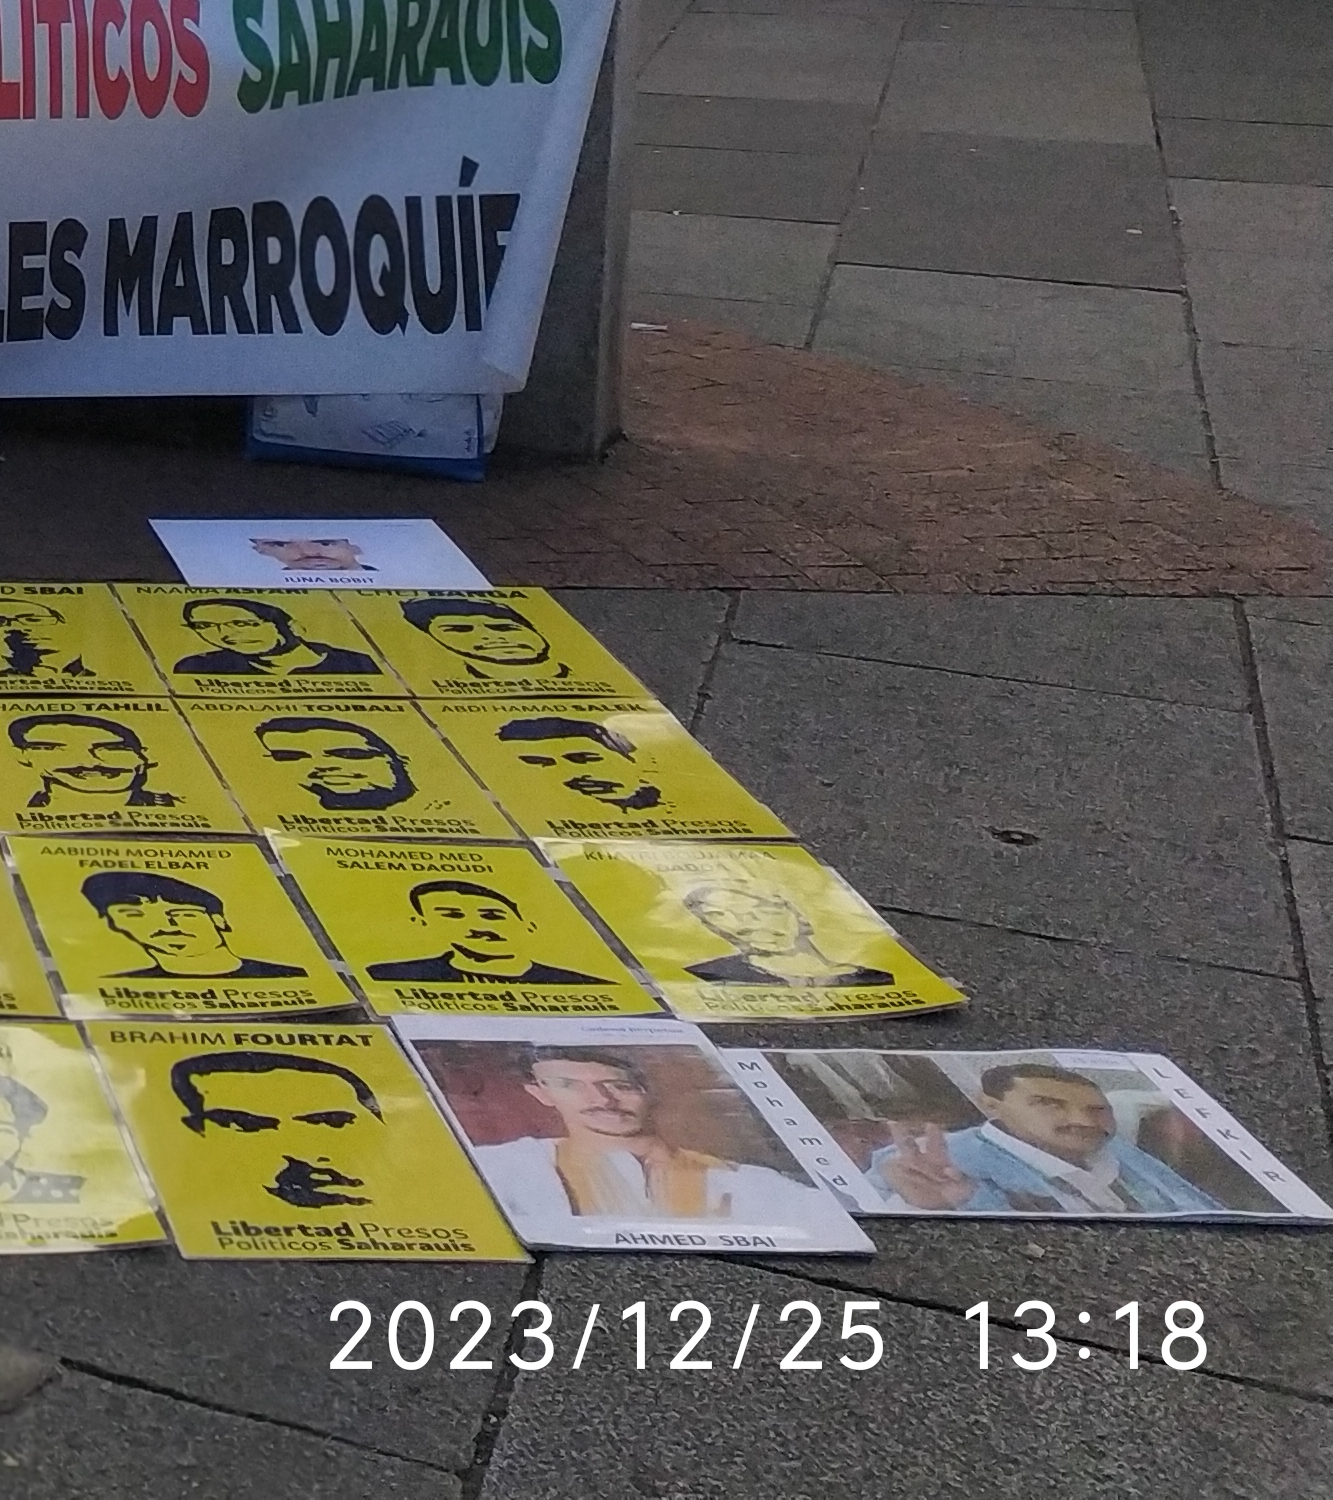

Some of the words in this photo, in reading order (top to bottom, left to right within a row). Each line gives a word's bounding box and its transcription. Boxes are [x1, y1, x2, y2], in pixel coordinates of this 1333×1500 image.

[284, 576, 324, 585] JUNA
[22, 584, 84, 595] SBAI
[136, 586, 221, 595] NAAMA
[81, 702, 169, 712] TAHLIL
[190, 702, 298, 713] ABDALAHI
[302, 703, 406, 713] TOUBALI
[440, 703, 488, 713] ABDI
[491, 703, 568, 713] HAMAD
[40, 845, 122, 856] AABIDIN
[126, 846, 233, 859] MOHAMED
[326, 846, 433, 862] MOHAMED
[438, 851, 484, 863] MED
[79, 859, 141, 869] FADEL
[144, 859, 211, 871] ELBAR
[337, 860, 408, 871] SALEM
[411, 861, 495, 874] DAOUDI
[98, 987, 218, 1000] Libertad
[223, 988, 314, 999] Presos
[394, 988, 518, 1002] Libertad
[521, 990, 615, 1004] Presos
[203, 997, 319, 1010] Saharauis
[502, 1000, 621, 1013] Saharauis
[110, 1031, 227, 1046] BRAHIM
[233, 1033, 374, 1048] FOURTAT
[210, 1220, 356, 1238] Libertad
[359, 1221, 470, 1240] Presos
[338, 1238, 476, 1253] Saharauis
[614, 1232, 707, 1246] AHMED
[721, 1234, 778, 1248] SBAI
